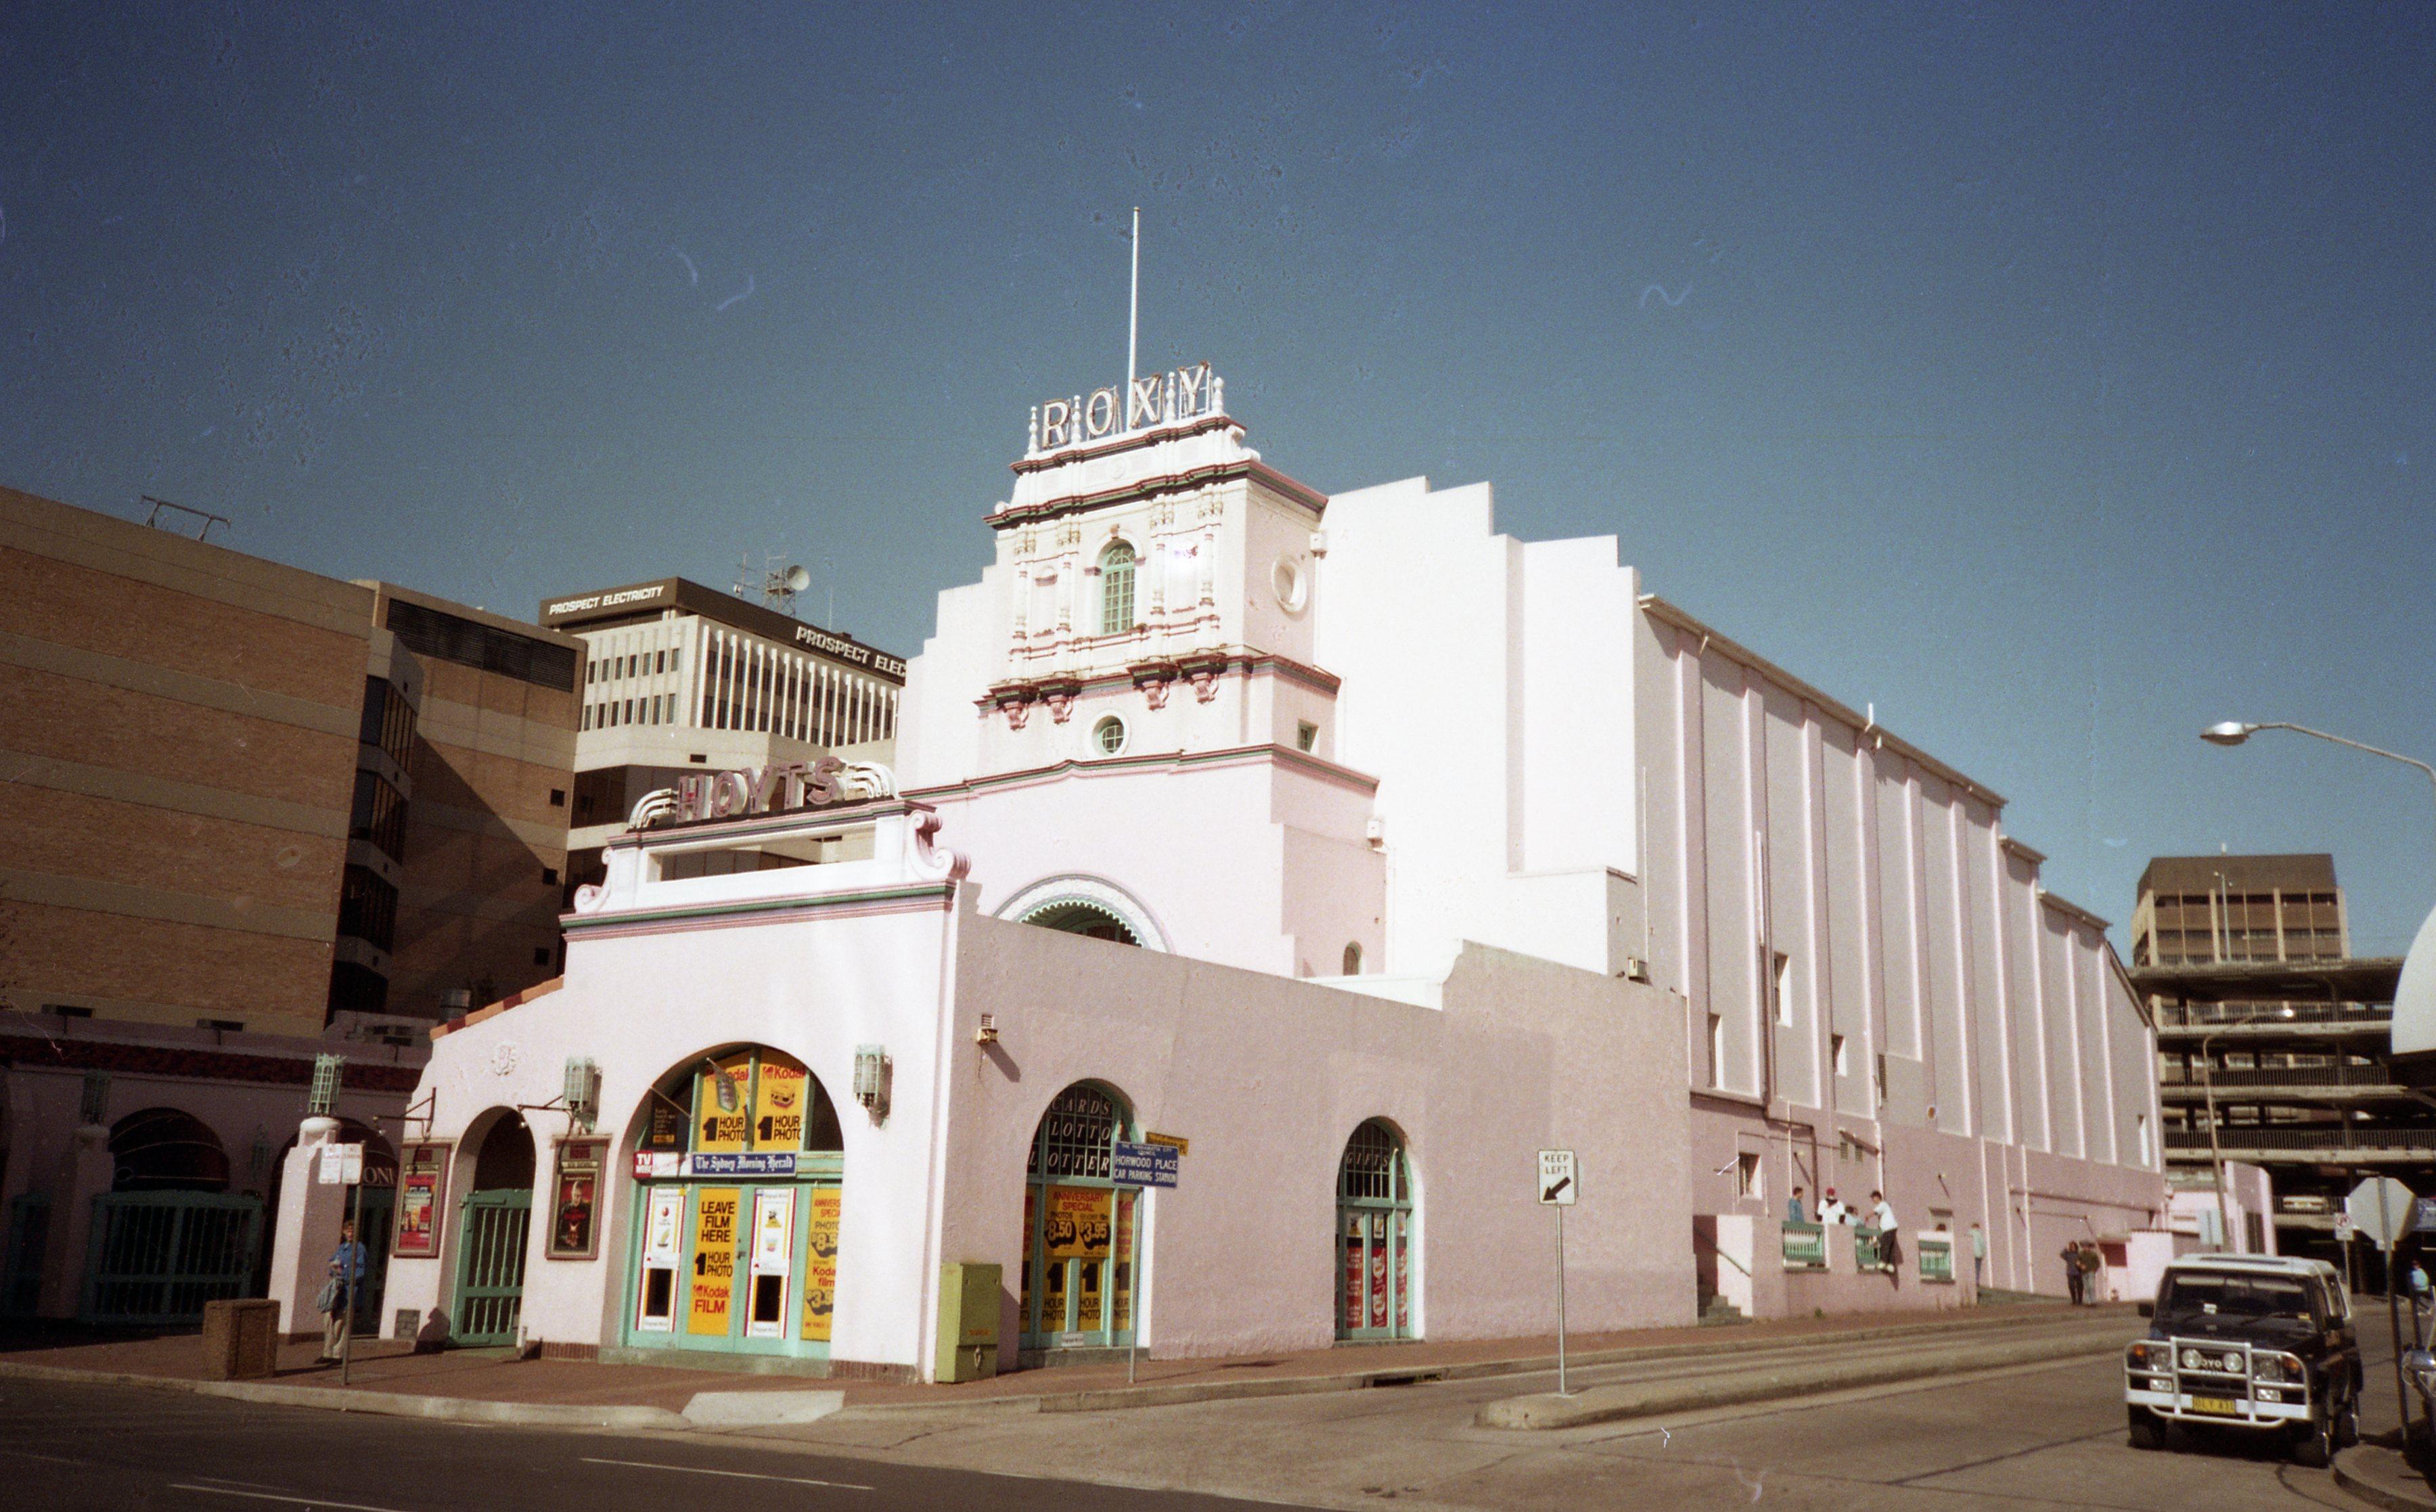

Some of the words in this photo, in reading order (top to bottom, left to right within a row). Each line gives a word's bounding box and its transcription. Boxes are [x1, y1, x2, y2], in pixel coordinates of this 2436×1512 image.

[1042, 361, 1210, 449] ROXY
[548, 596, 601, 616] PROSPECT
[602, 585, 664, 607] ELECTRICITY
[796, 625, 871, 664] PROSPECT
[875, 654, 907, 677] ELEC
[677, 756, 846, 823] HOYTS
[1051, 1096, 1110, 1116] CARDS
[702, 1117, 719, 1142] 1
[719, 1117, 744, 1128] HOUR
[757, 1116, 773, 1141] 1
[773, 1115, 800, 1128] HOUR
[1051, 1121, 1110, 1141] LOTTO
[637, 1153, 652, 1165] TV
[695, 1155, 709, 1170] The
[710, 1155, 736, 1172] Sydney
[736, 1155, 766, 1172] Morning
[767, 1155, 793, 1172] Herald
[1115, 1155, 1152, 1168] HORWOOD
[1154, 1159, 1177, 1170] PLACE
[1544, 1154, 1569, 1163] KEEP
[1114, 1168, 1127, 1179] CAR
[1128, 1169, 1152, 1182] PARKING
[1155, 1171, 1176, 1184] STATION
[1545, 1166, 1567, 1174] LEFT
[1053, 1191, 1104, 1201] ANNIVERSARY
[701, 1201, 736, 1215] LEAVE
[1062, 1201, 1094, 1212] SPECIAL
[704, 1215, 730, 1229] FILM
[701, 1230, 731, 1243] HERE
[694, 1252, 706, 1276] 1
[707, 1252, 730, 1264] HOUR
[706, 1264, 734, 1278] PHOTO
[1046, 1262, 1064, 1293] 1
[1082, 1262, 1099, 1293] 1
[703, 1284, 730, 1299] Kodak
[694, 1299, 725, 1314] FILM
[1044, 1297, 1063, 1308] HOUR
[1080, 1297, 1099, 1308] HOUR
[1042, 1308, 1065, 1321] PHOTO
[1079, 1308, 1100, 1320] PHOTO
